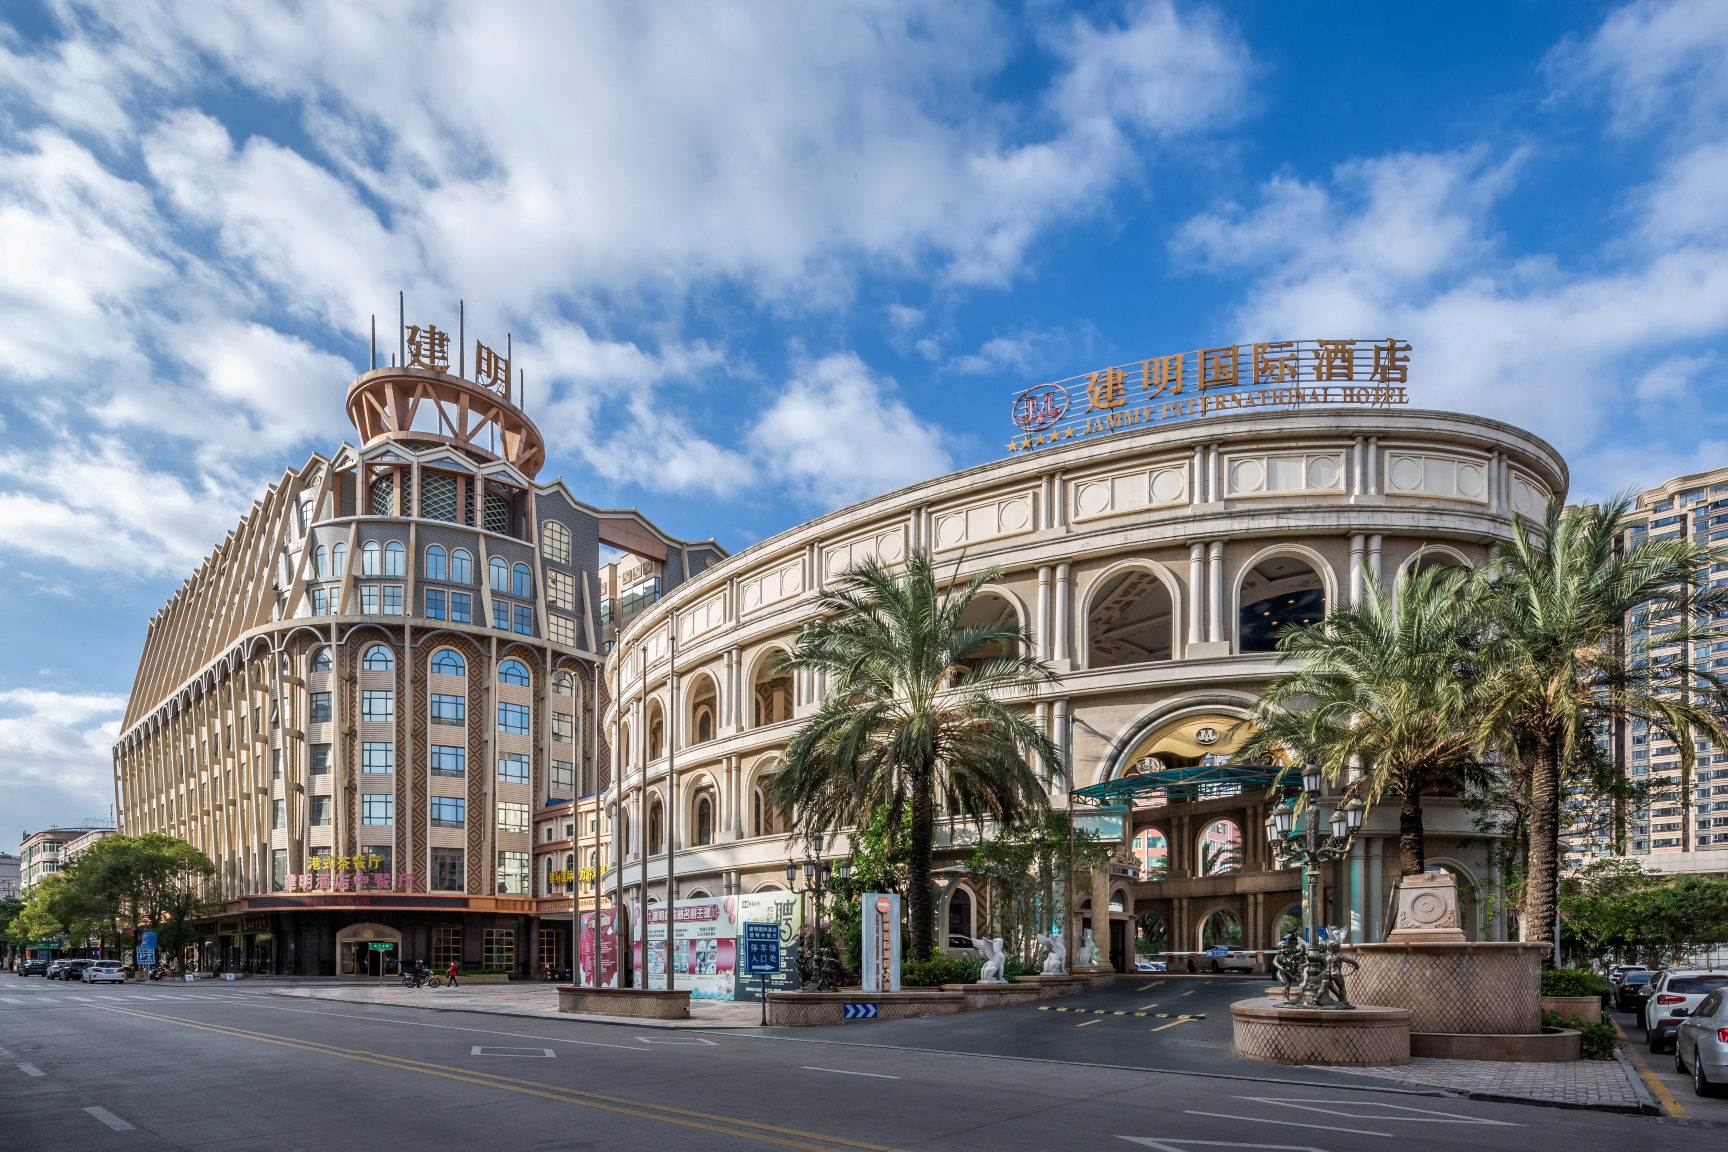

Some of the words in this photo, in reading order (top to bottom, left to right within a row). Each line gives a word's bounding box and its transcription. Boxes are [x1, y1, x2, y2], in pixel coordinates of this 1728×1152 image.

[405, 324, 511, 400] 建明
[1084, 338, 1412, 413] 建明国际酒店
[1083, 406, 1154, 435] JAMMY
[1163, 387, 1334, 420] INTERNATIONAL
[1342, 387, 1410, 405] HOTEL
[307, 856, 382, 870] 港式茶餐厅
[284, 873, 415, 890] 建明酒店中餐厅
[750, 944, 776, 952] 停车场
